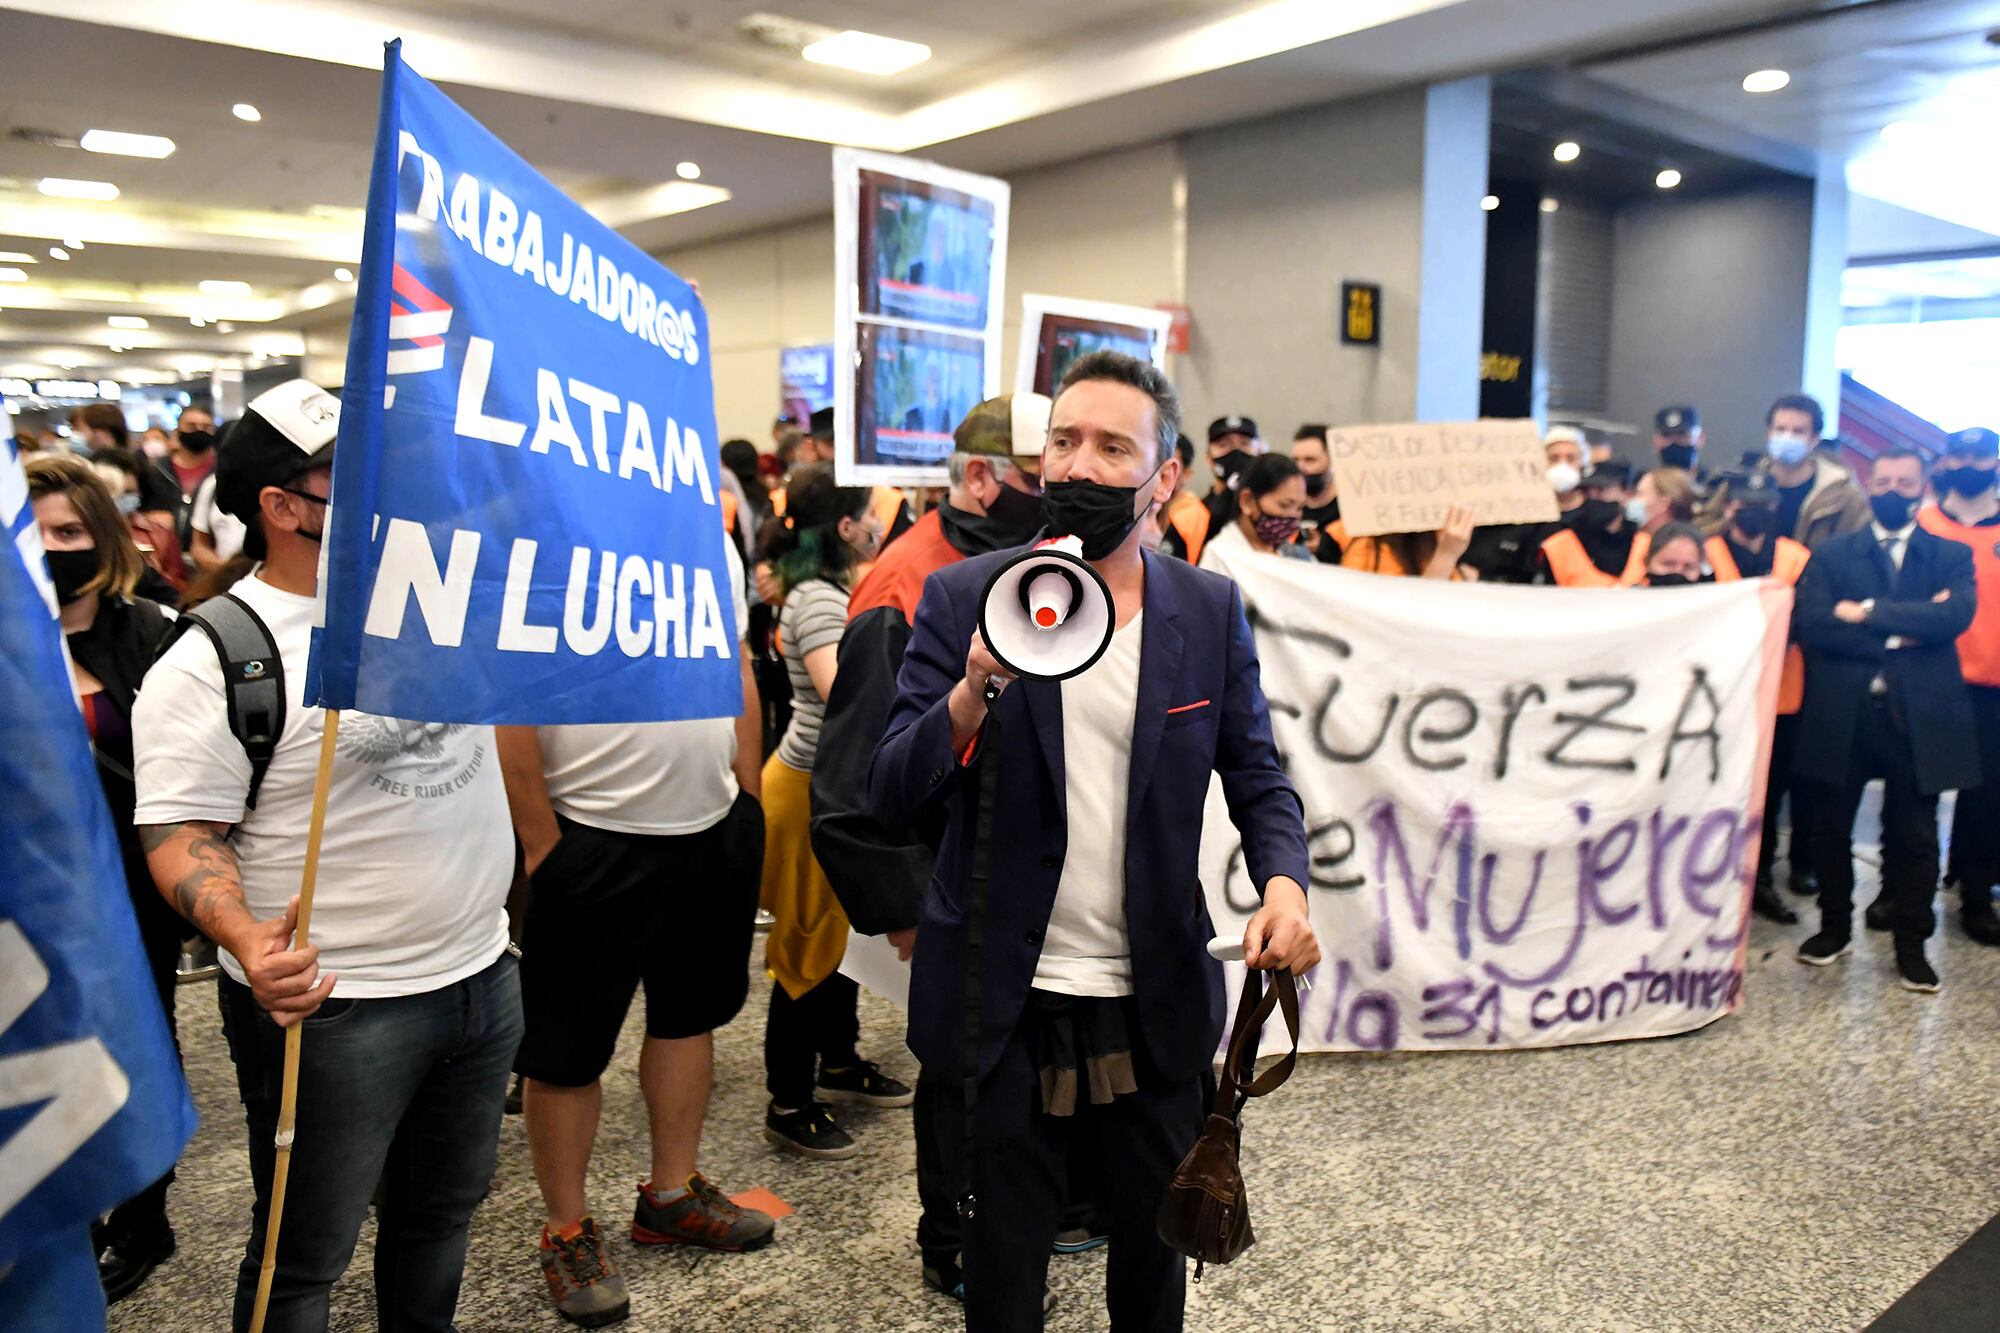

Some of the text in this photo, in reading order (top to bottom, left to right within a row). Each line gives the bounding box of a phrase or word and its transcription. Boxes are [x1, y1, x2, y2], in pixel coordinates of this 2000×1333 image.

[454, 336, 716, 506] LATAM
[364, 515, 731, 659] N LUCHA
[370, 774, 409, 797] FREE
[415, 782, 455, 799] RIDER
[454, 743, 485, 790] CULTURE
[1419, 977, 1502, 1045] 31
